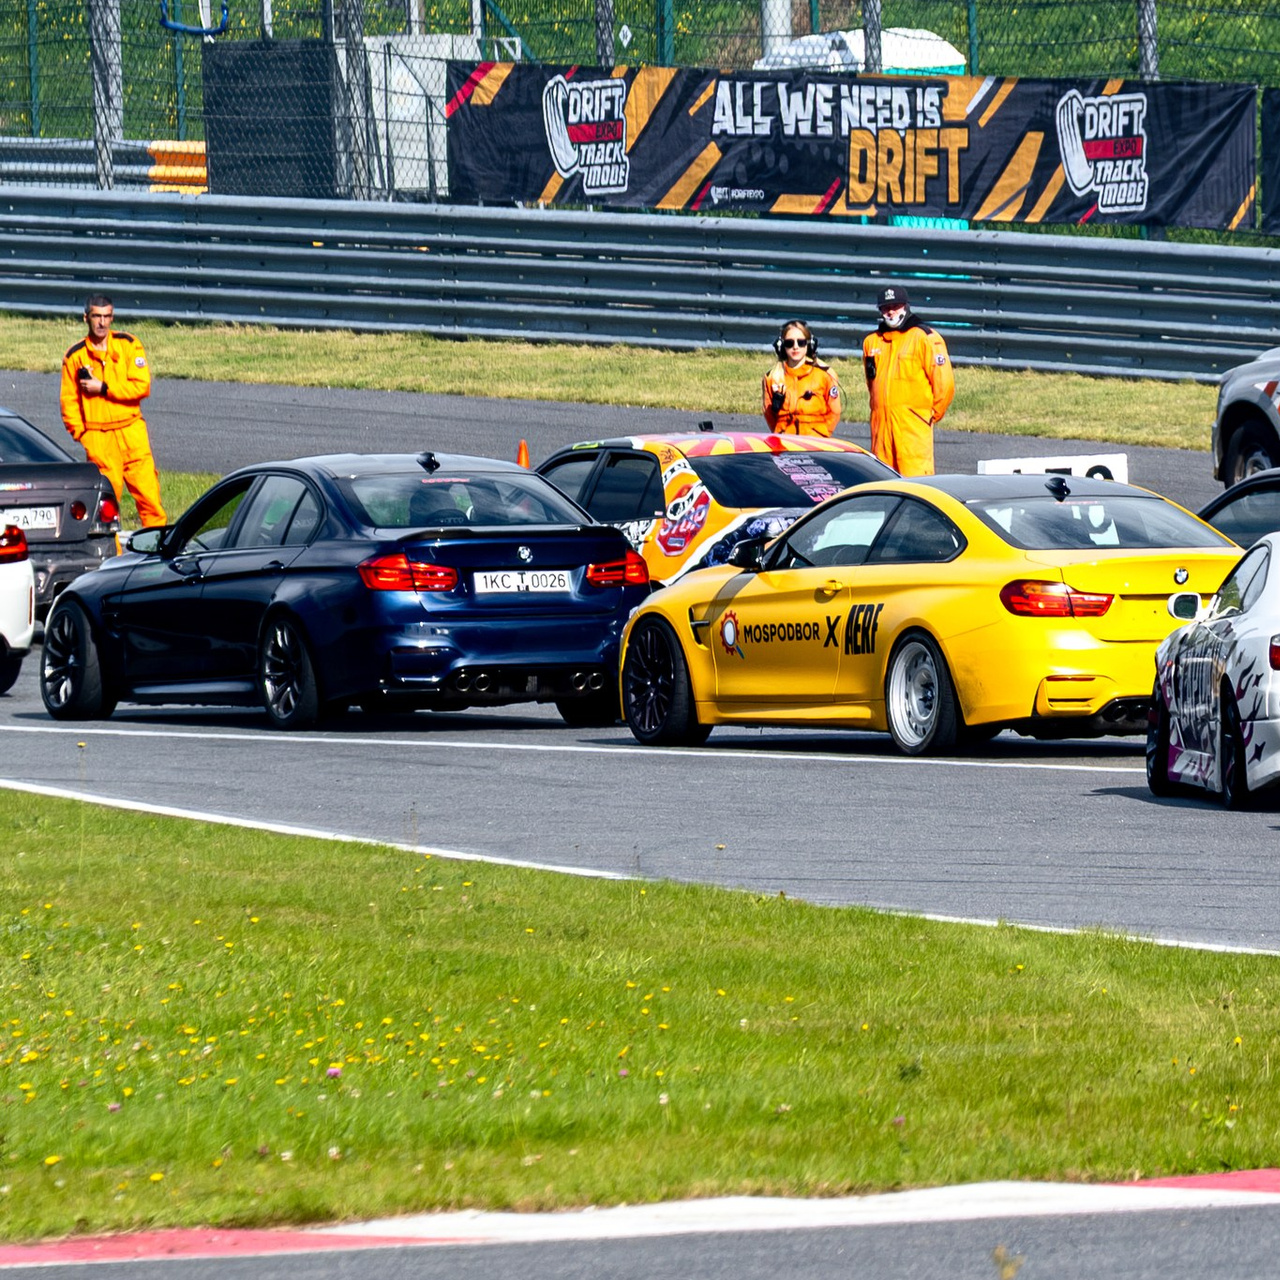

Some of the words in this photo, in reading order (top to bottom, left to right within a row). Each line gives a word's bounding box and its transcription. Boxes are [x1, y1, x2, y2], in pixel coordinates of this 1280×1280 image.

[568, 87, 623, 123] DRIFT
[711, 80, 775, 136] ALL
[777, 81, 838, 136] WE
[840, 84, 912, 136] NEED
[595, 122, 618, 139] EXPO
[1084, 101, 1144, 139] DRIFT
[1113, 139, 1137, 155] EXPO
[849, 128, 969, 204] DRIFT
[32, 509, 53, 522] 790
[483, 574, 512, 589] 1KC
[531, 573, 566, 588] 0026
[743, 622, 820, 643] MOSPODBOR
